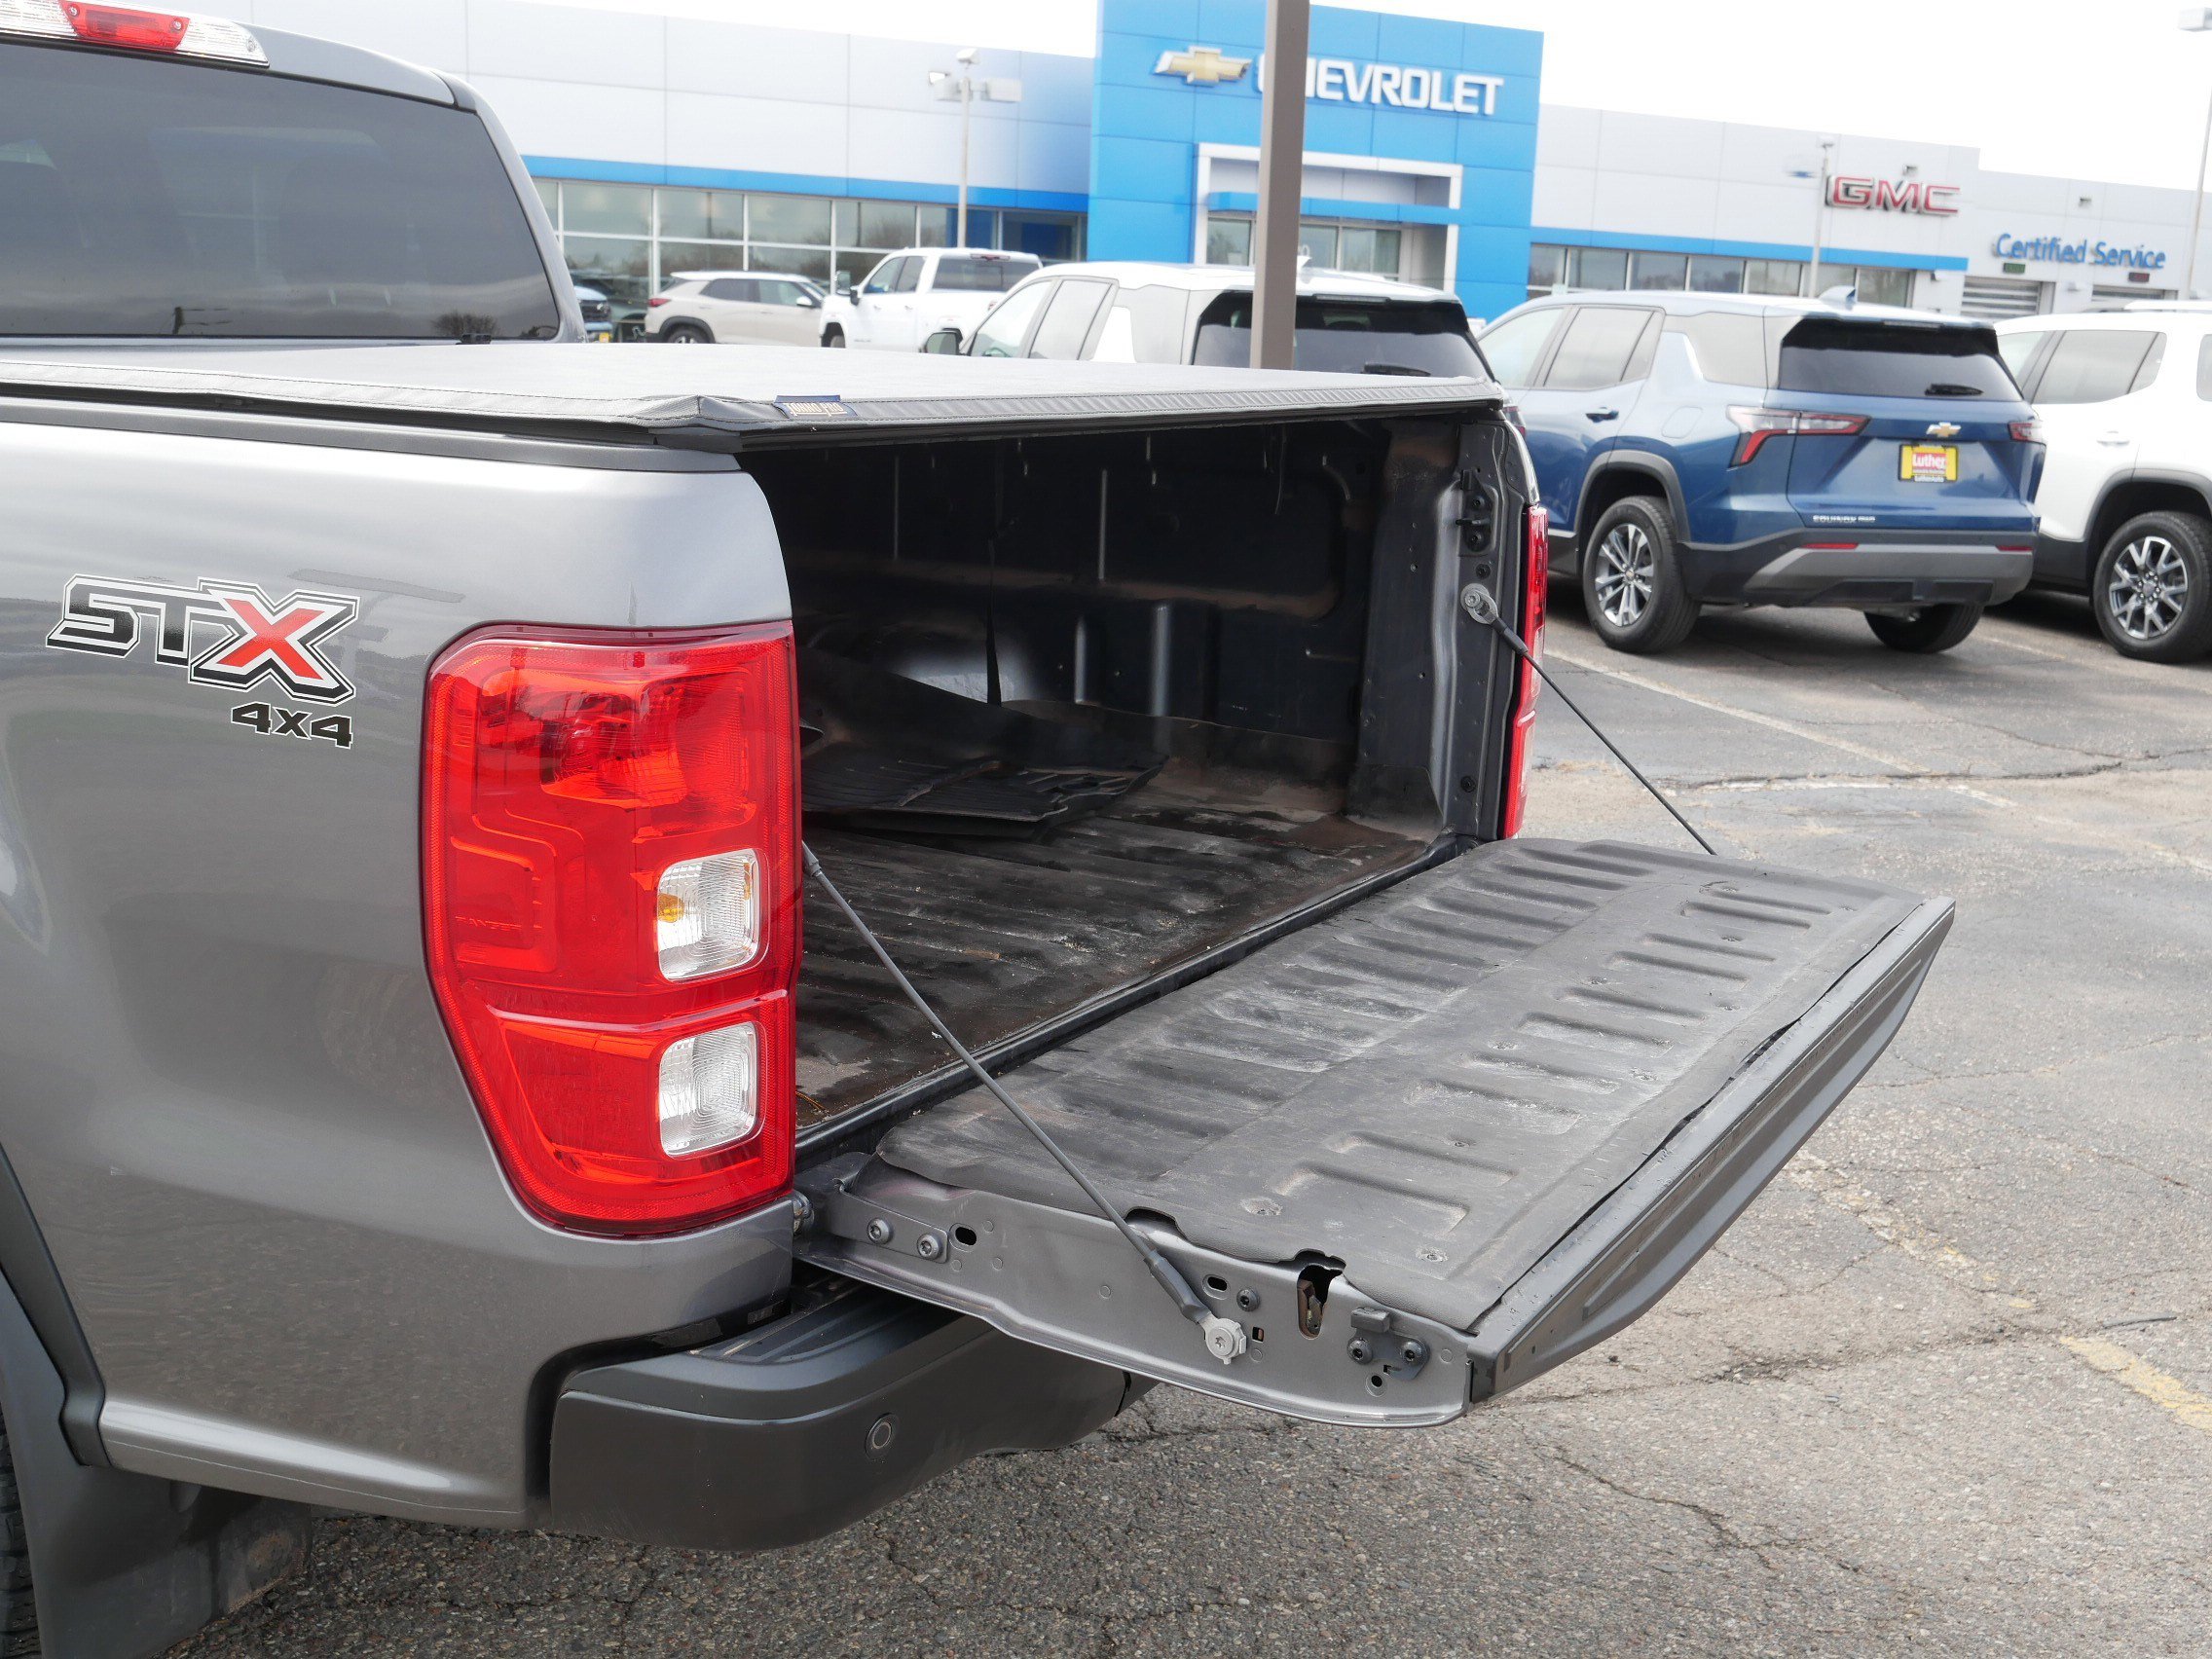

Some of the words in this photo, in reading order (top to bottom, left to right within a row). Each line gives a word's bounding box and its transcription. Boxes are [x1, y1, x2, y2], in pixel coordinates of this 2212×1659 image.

[1257, 53, 1504, 116] EVROLET
[1826, 175, 1961, 216] GMC
[1995, 233, 2087, 264] Certified
[2092, 240, 2166, 270] Service
[1912, 453, 1947, 469] Luther
[46, 573, 360, 707] STX
